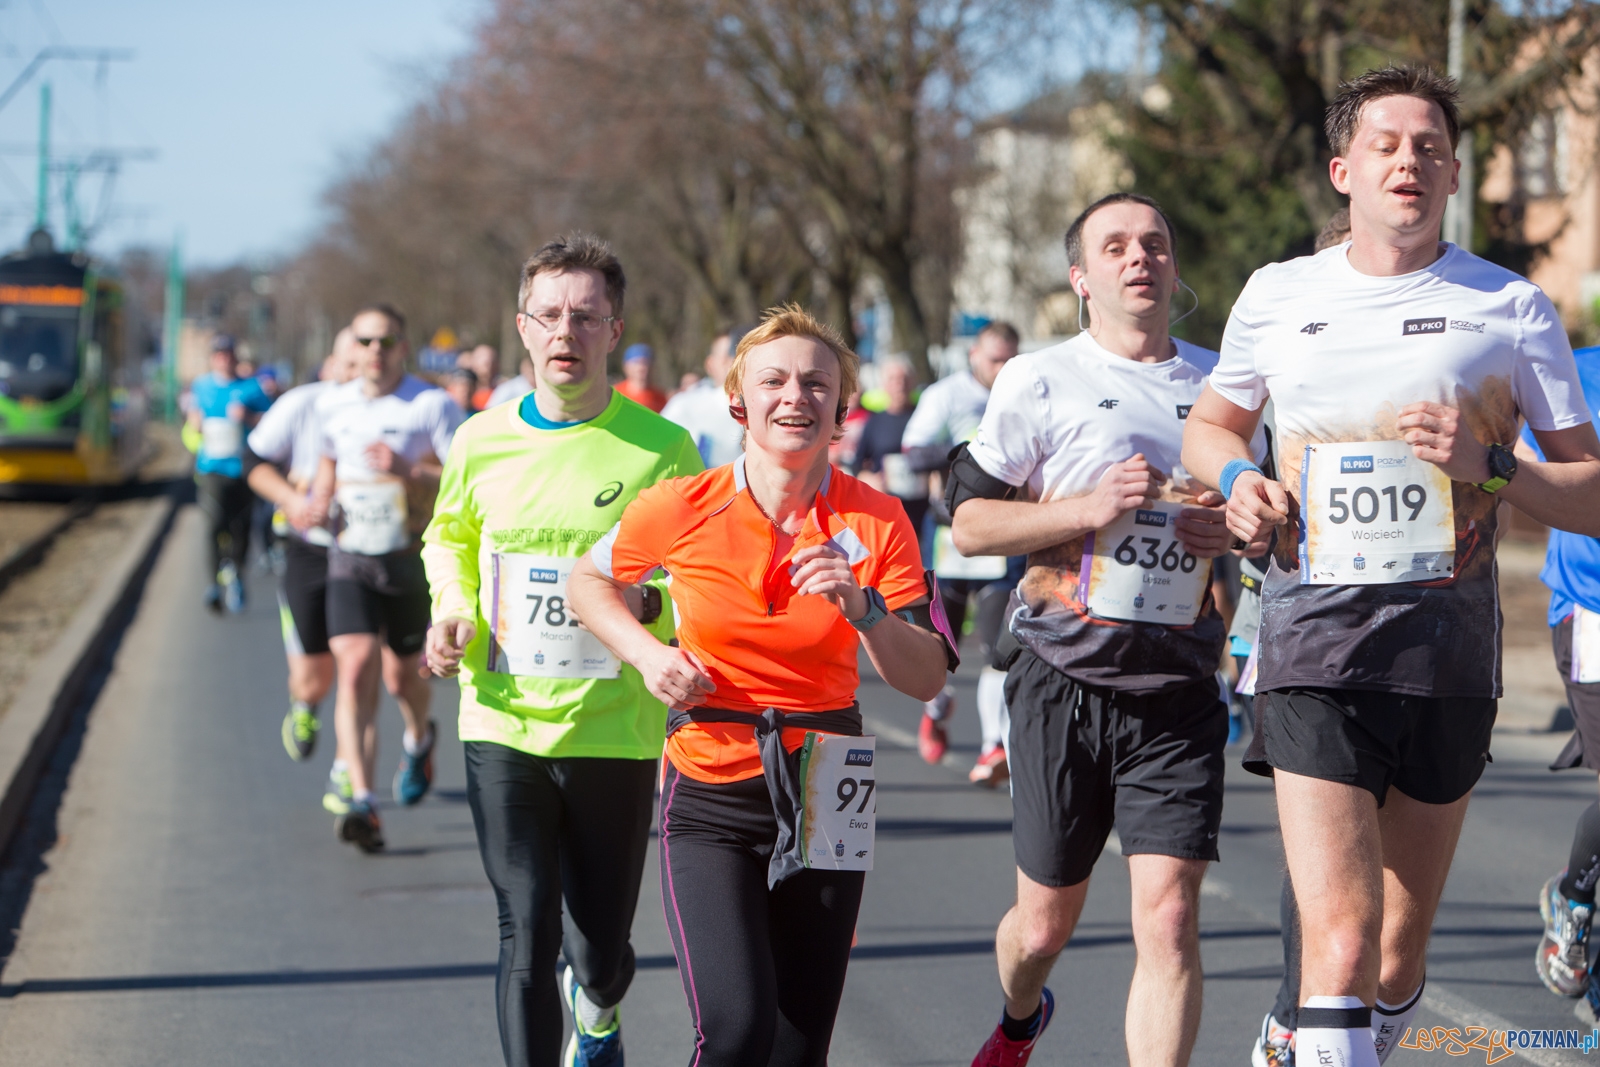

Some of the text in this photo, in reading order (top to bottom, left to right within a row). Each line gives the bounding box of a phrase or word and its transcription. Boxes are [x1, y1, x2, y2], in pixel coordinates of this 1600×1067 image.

[1300, 322, 1329, 335] 4F
[1407, 321, 1443, 332] 10. PKO
[1098, 399, 1119, 409] 4F
[1343, 460, 1371, 469] 10. PKO
[1328, 484, 1427, 524] 5019
[1138, 513, 1148, 521] 10.
[1149, 515, 1165, 524] PKO
[538, 528, 555, 542] IT
[1351, 529, 1404, 542] Wojciech
[542, 572, 557, 581] PKO
[1142, 575, 1172, 586] Leszek
[540, 631, 573, 641] Marcin
[857, 754, 872, 762] PKO
[835, 777, 876, 814] 97
[849, 819, 869, 830] Ewa
